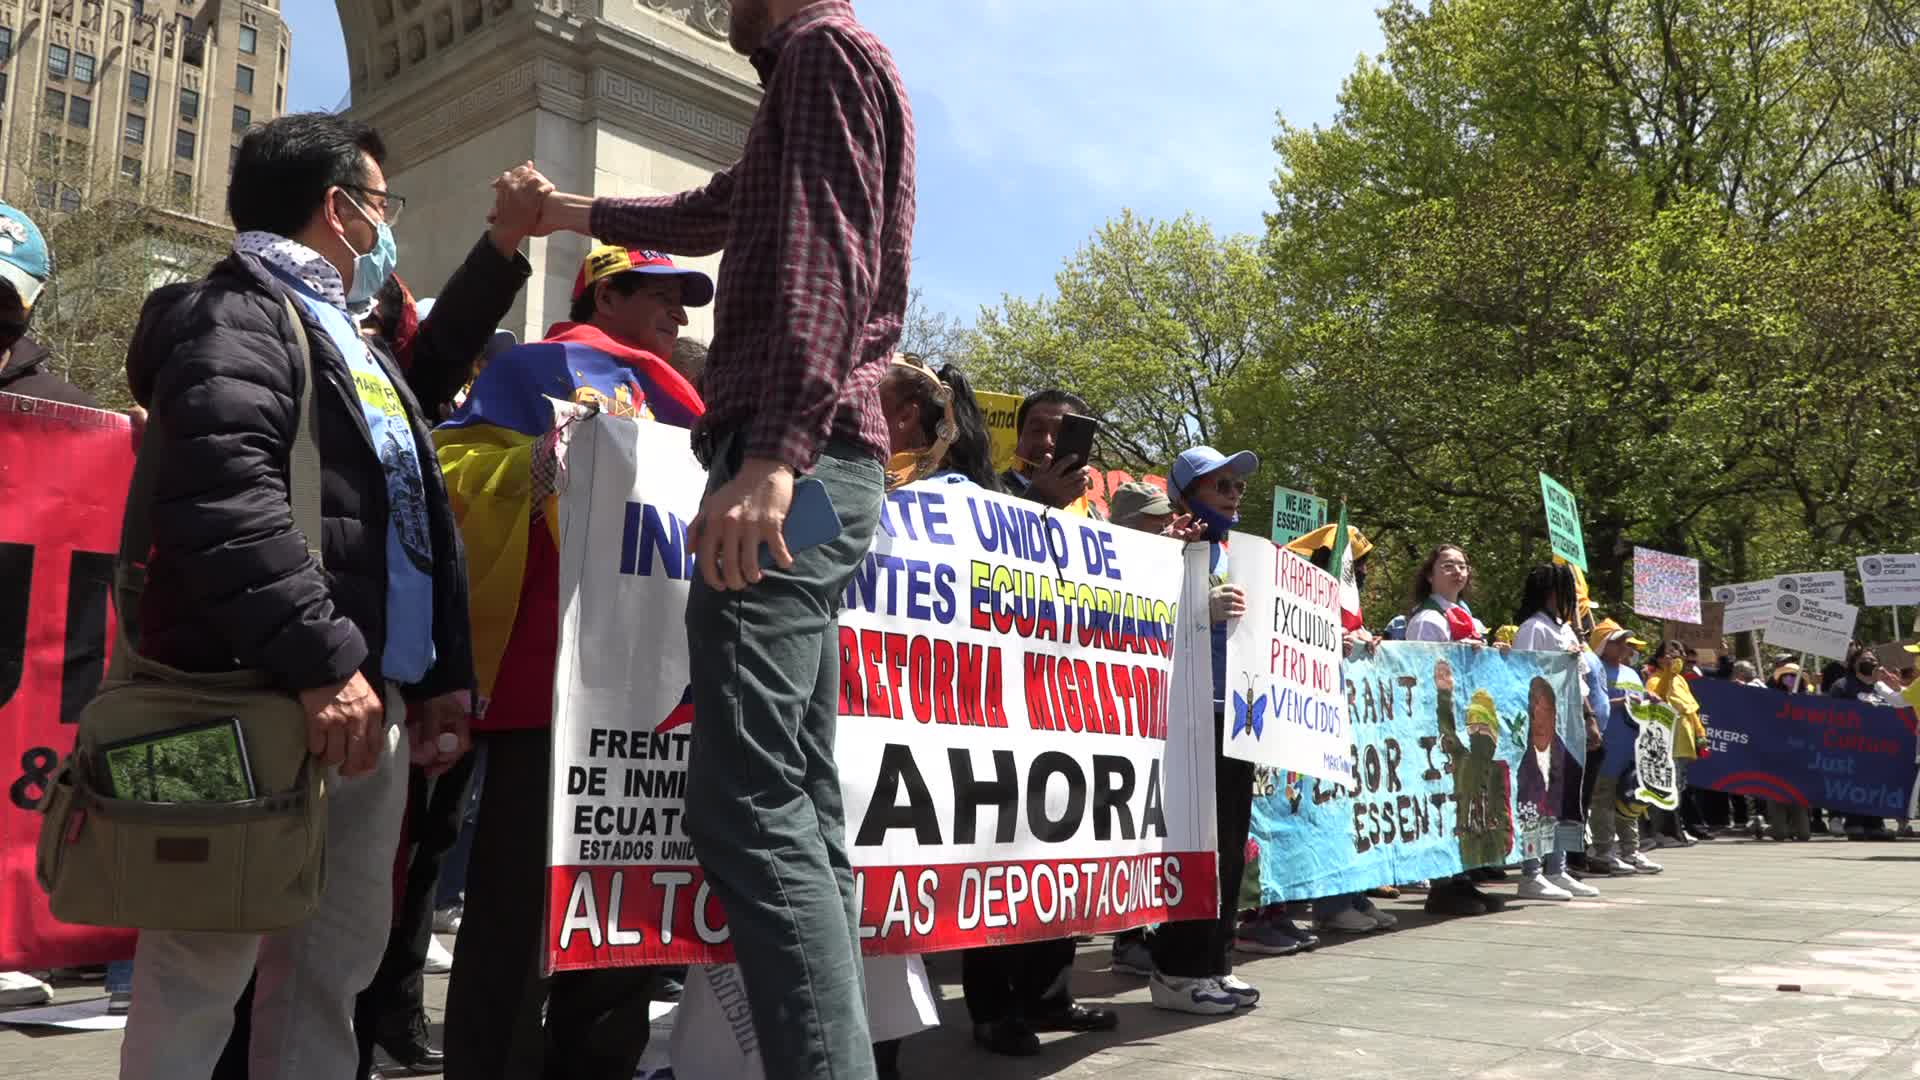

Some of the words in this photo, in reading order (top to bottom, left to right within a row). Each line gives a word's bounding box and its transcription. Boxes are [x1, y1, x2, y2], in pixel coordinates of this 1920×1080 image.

[1285, 493, 1297, 512] WE
[1297, 497, 1312, 516] ARE
[967, 497, 1069, 569] UNIDO
[1079, 525, 1121, 580] DE
[846, 551, 956, 624] NTES
[1800, 611, 1830, 623] CIRCLE
[1802, 605, 1844, 620] WORKERS
[1804, 599, 1820, 608] THE
[838, 625, 1008, 728] REFORMA
[1268, 638, 1306, 685] PERO
[1313, 658, 1331, 693] NO
[1271, 684, 1340, 738] VENCIDOS
[1776, 703, 1862, 728] Jewish
[589, 728, 691, 761] FRENT
[1706, 727, 1749, 744] RKERS
[1808, 751, 1855, 774] Just
[567, 765, 607, 797] DE
[623, 768, 687, 799] INMI
[854, 743, 1168, 846] AHORA
[1824, 778, 1904, 808] World
[580, 839, 652, 861] ESTADOS
[855, 868, 939, 938] LAS
[957, 855, 1184, 931] DEPORTACIONES
